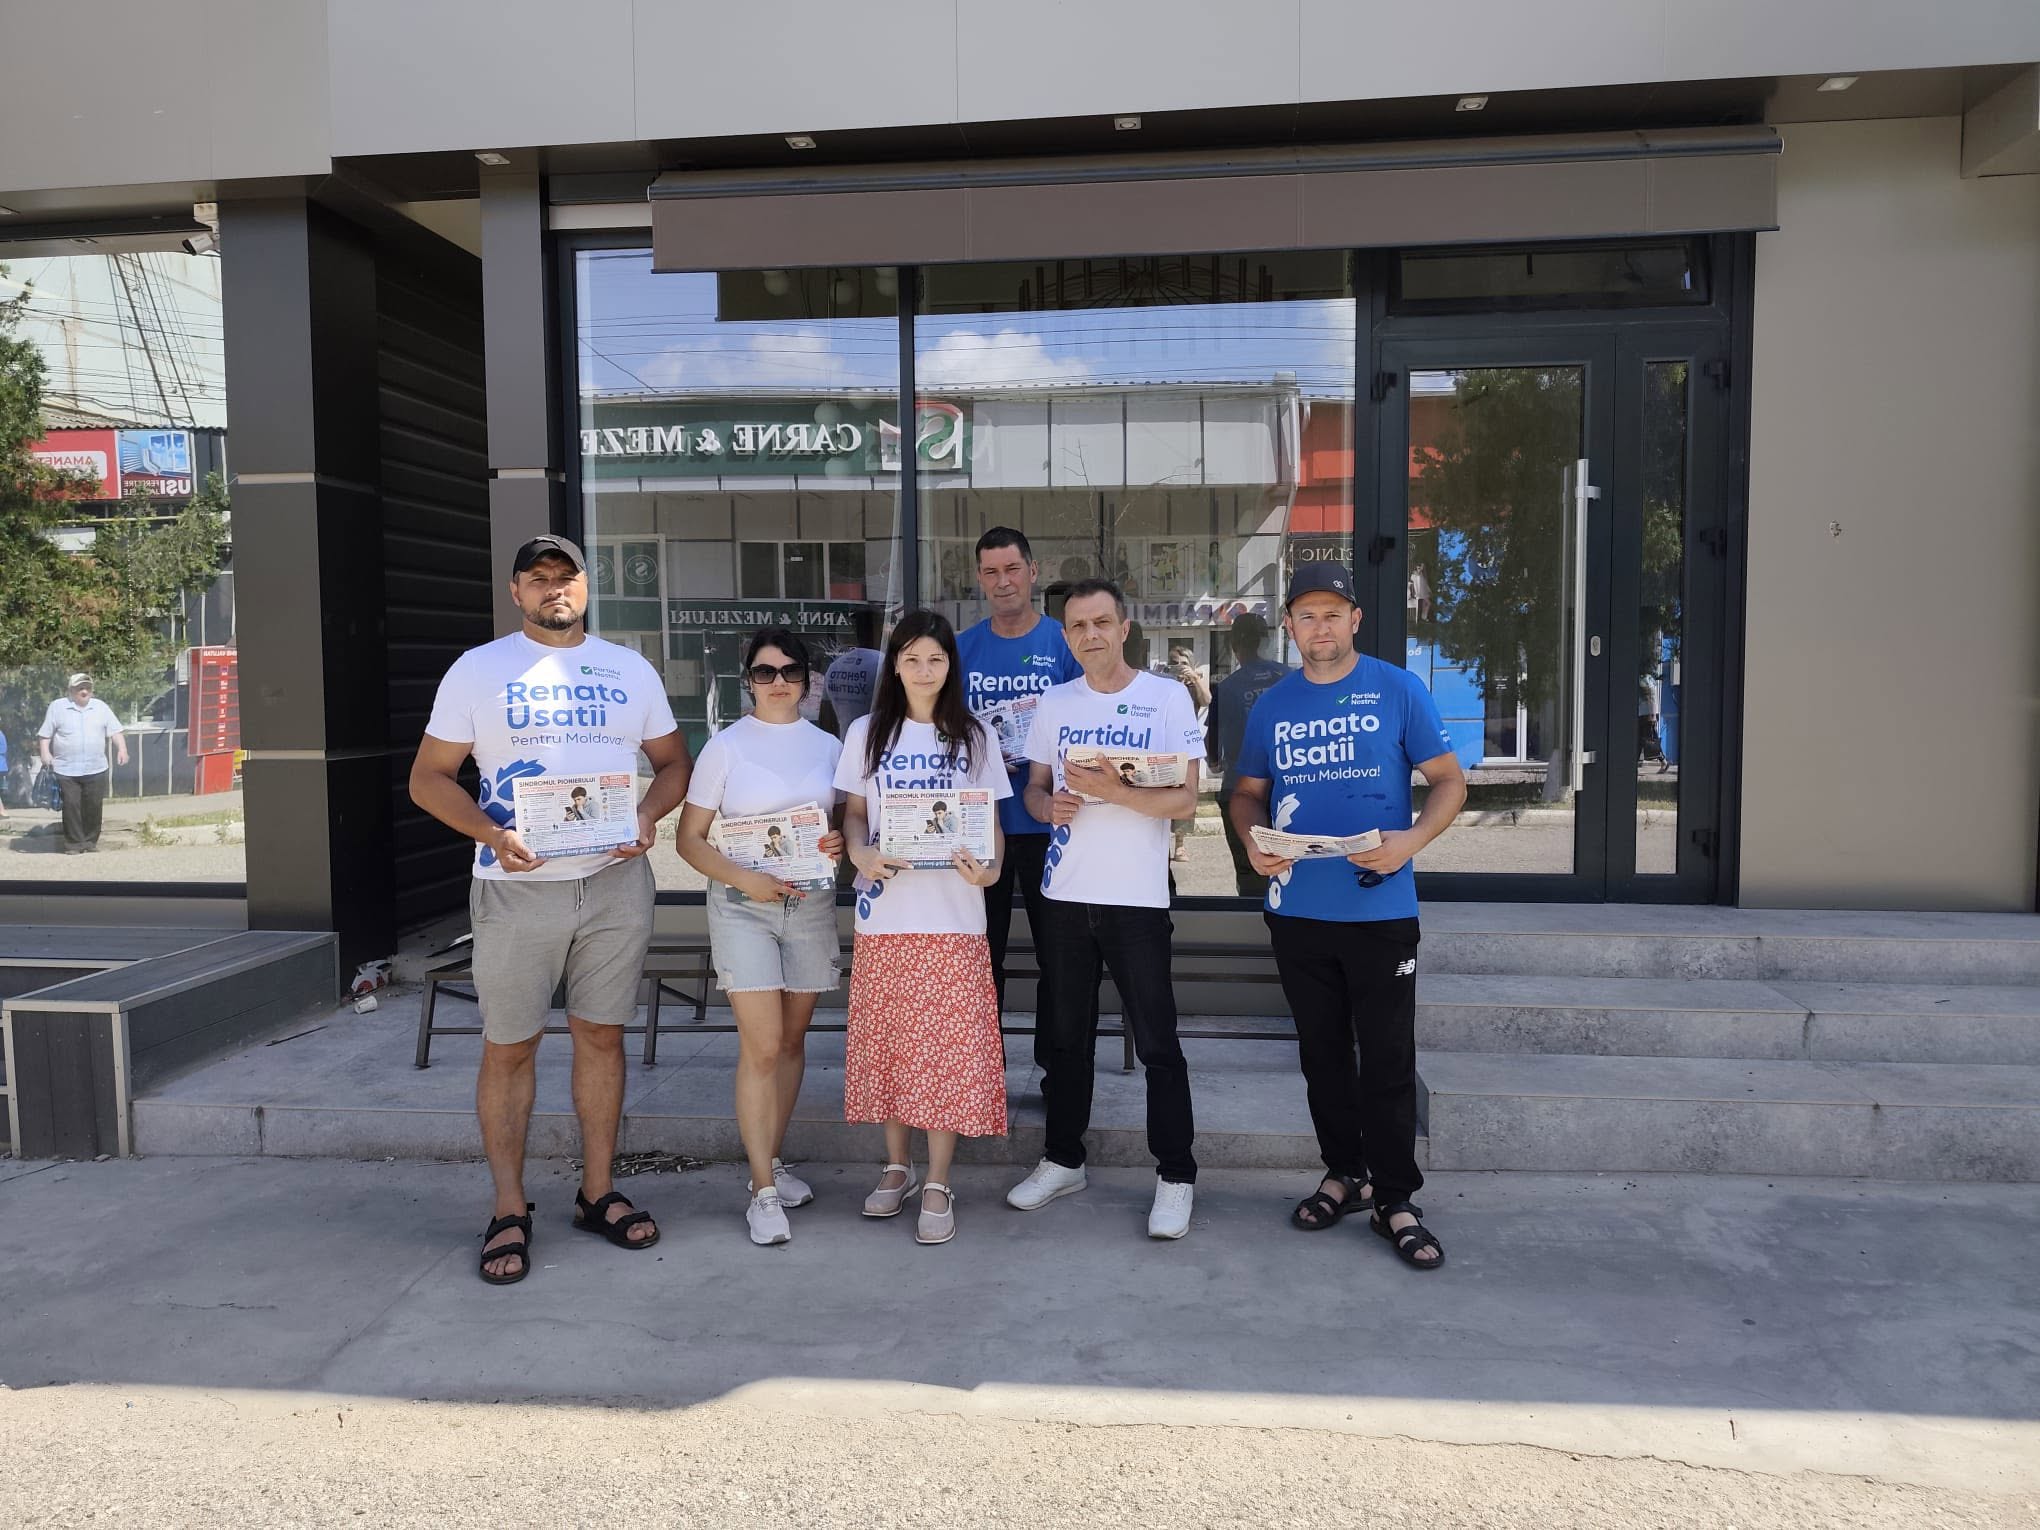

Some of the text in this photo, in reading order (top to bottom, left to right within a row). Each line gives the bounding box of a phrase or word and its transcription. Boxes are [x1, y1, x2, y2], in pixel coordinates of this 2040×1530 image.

[506, 681, 628, 704] Renato
[968, 671, 1052, 693] Renato
[1351, 692, 1381, 700] Partidul
[506, 704, 607, 730] Usatîi
[1131, 703, 1158, 713] Renato
[511, 733, 626, 747] Pentru Moldova!
[1058, 724, 1152, 750] Partidul
[1274, 713, 1380, 746] Renato
[1275, 735, 1355, 771] Usatîi
[519, 779, 556, 788] SINDROMUL
[1318, 765, 1381, 782] Moldova!
